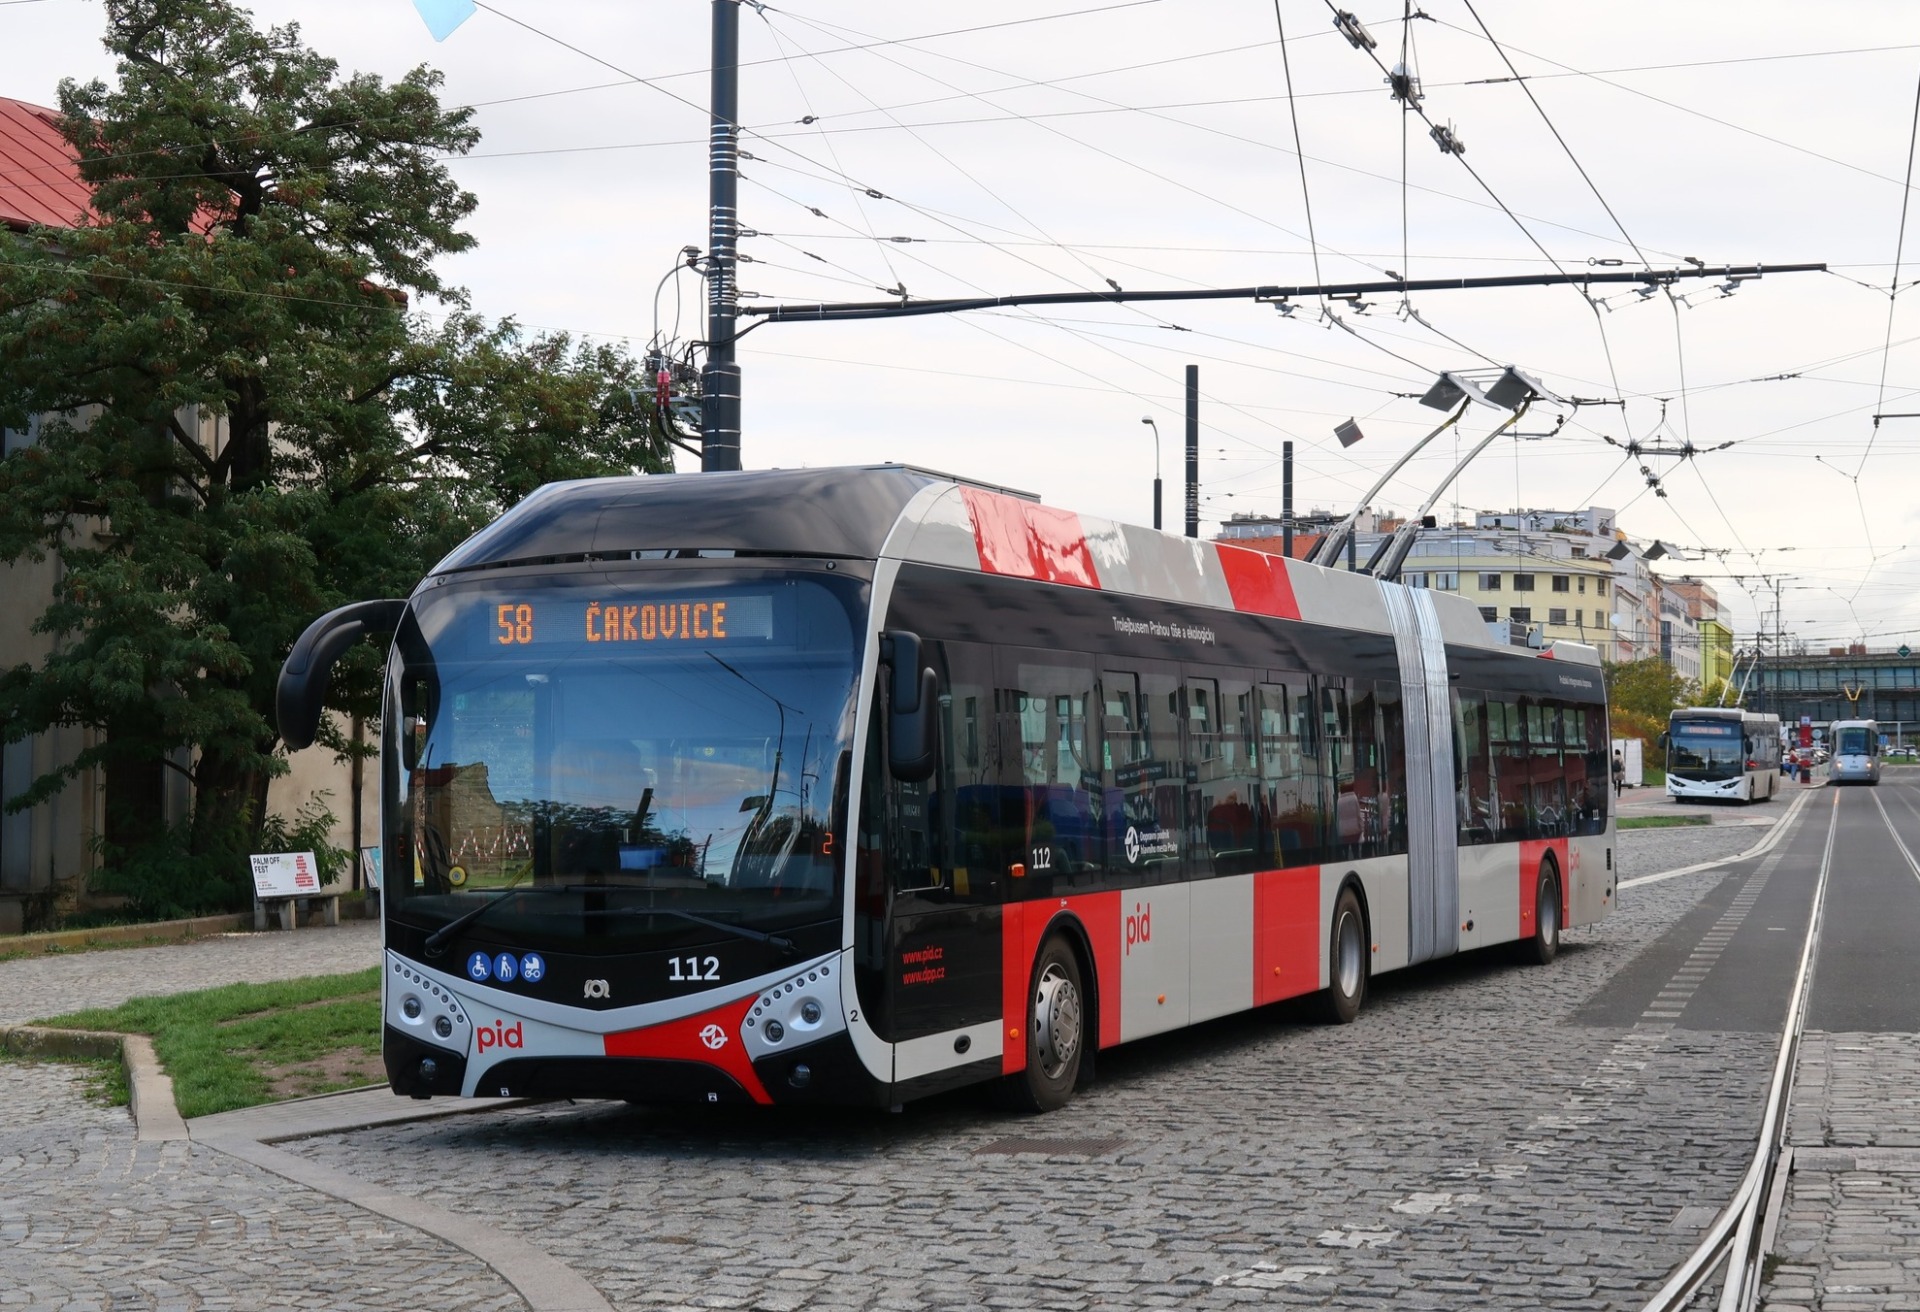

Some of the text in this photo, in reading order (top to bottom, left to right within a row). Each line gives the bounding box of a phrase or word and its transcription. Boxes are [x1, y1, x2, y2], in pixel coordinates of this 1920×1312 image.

[498, 602, 726, 644] 58 ČAKOVICE
[1112, 616, 1149, 636] Trolejbusem
[1149, 620, 1170, 637] Prahou
[1186, 625, 1216, 645] ekologicky
[823, 832, 833, 855] 2
[253, 856, 280, 865] PALM OFF
[254, 865, 268, 873] FEST
[1033, 847, 1050, 869] 112
[1126, 902, 1150, 956] pid
[903, 945, 942, 964] www.pid.cz
[668, 956, 720, 981] 112
[903, 966, 944, 984] www.dpp.cz
[850, 1009, 858, 1022] 2
[476, 1019, 523, 1053] pid
